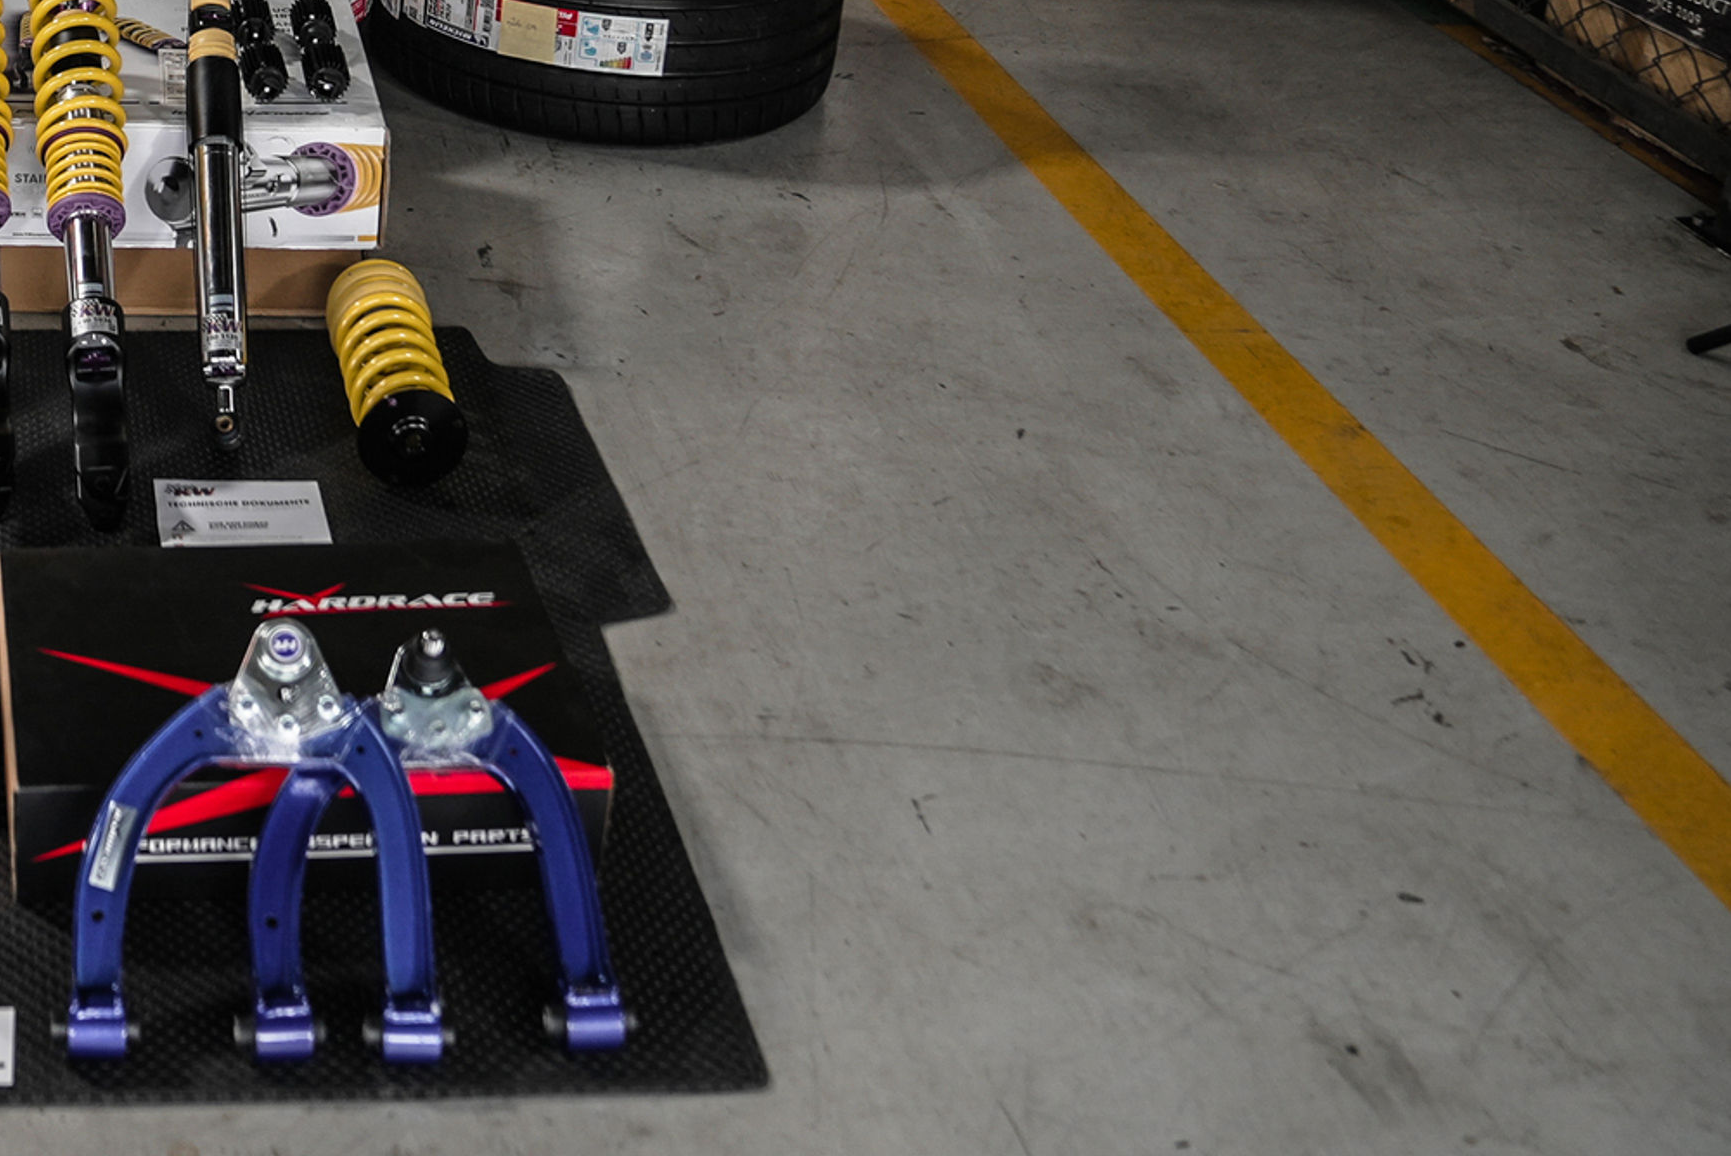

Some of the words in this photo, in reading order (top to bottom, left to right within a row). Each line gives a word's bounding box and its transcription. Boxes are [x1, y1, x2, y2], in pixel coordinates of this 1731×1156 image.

[428, 17, 473, 40] MICHELIN
[79, 303, 115, 318] KW
[166, 499, 239, 509] TECHNISCHE
[241, 498, 310, 508] DOKUMENTE
[252, 591, 497, 614] HARDRACE
[136, 836, 258, 854] FORMANC
